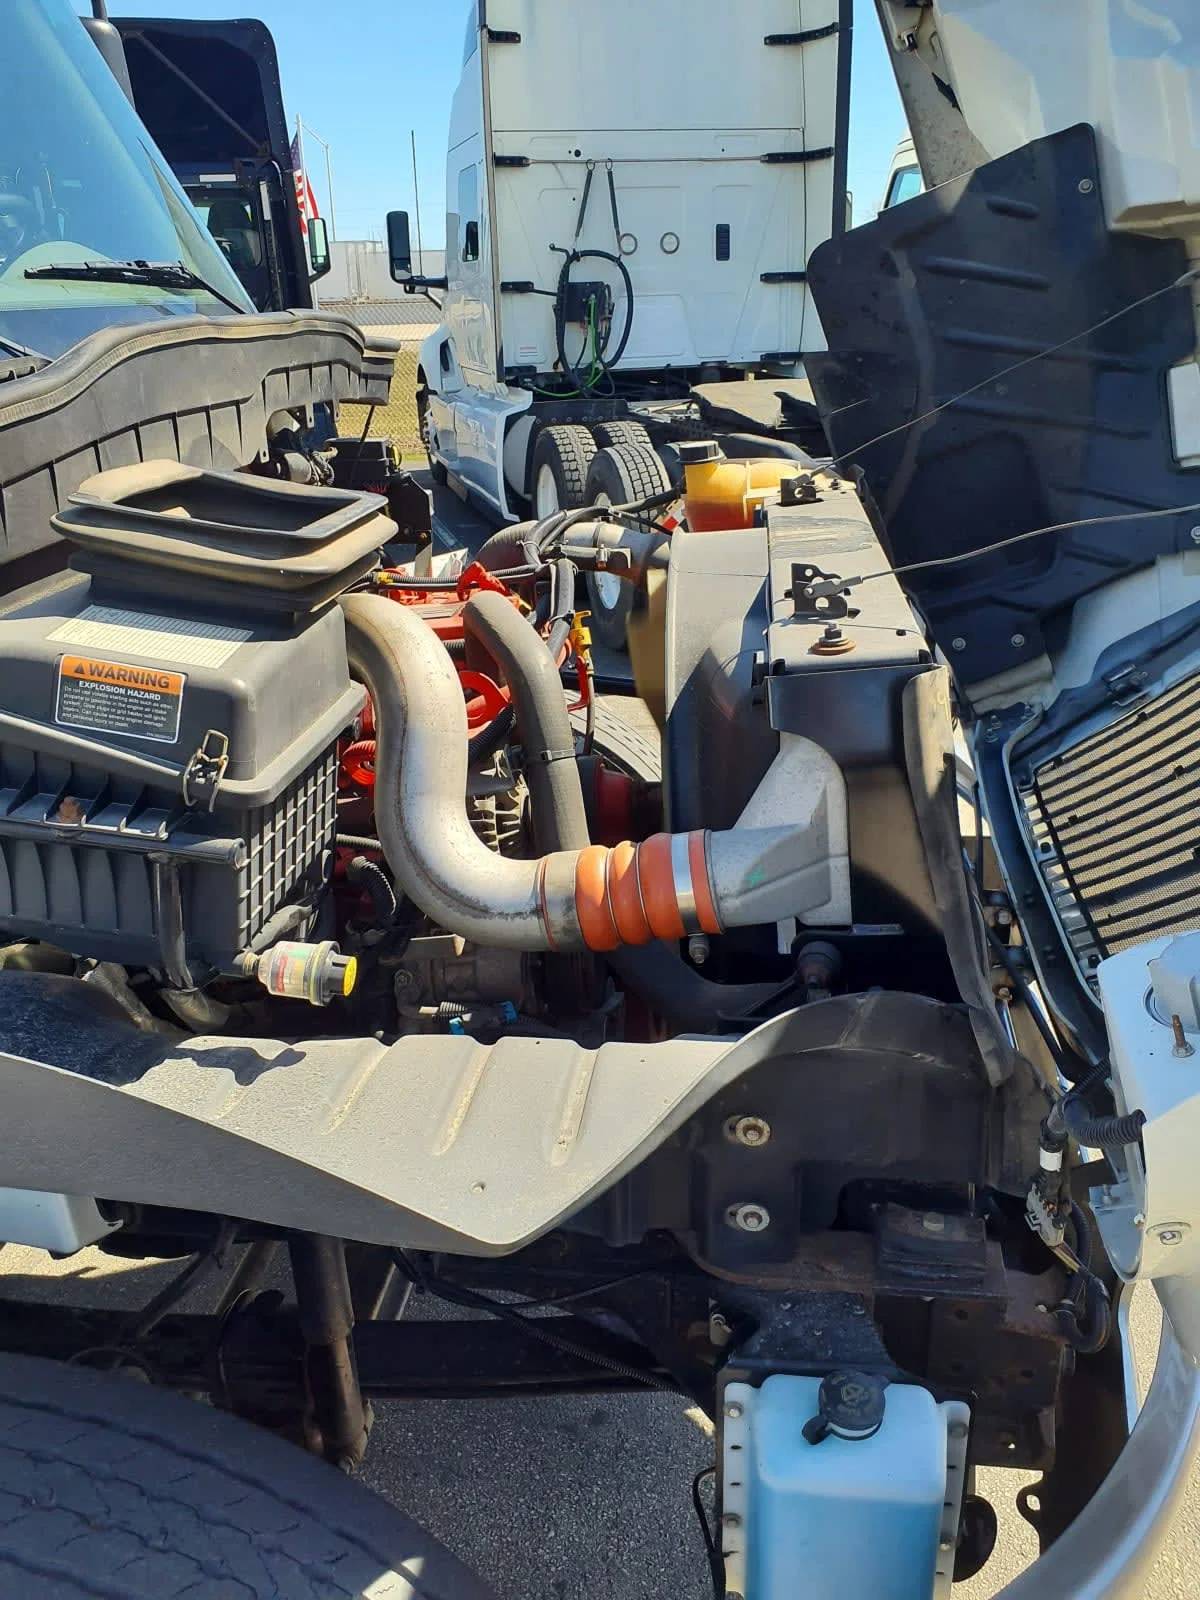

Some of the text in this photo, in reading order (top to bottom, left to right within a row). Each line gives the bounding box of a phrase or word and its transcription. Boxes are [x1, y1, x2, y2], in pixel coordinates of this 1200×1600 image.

[89, 662, 170, 688] WARNING
[80, 680, 160, 700] EXPLOSION HAZARD
